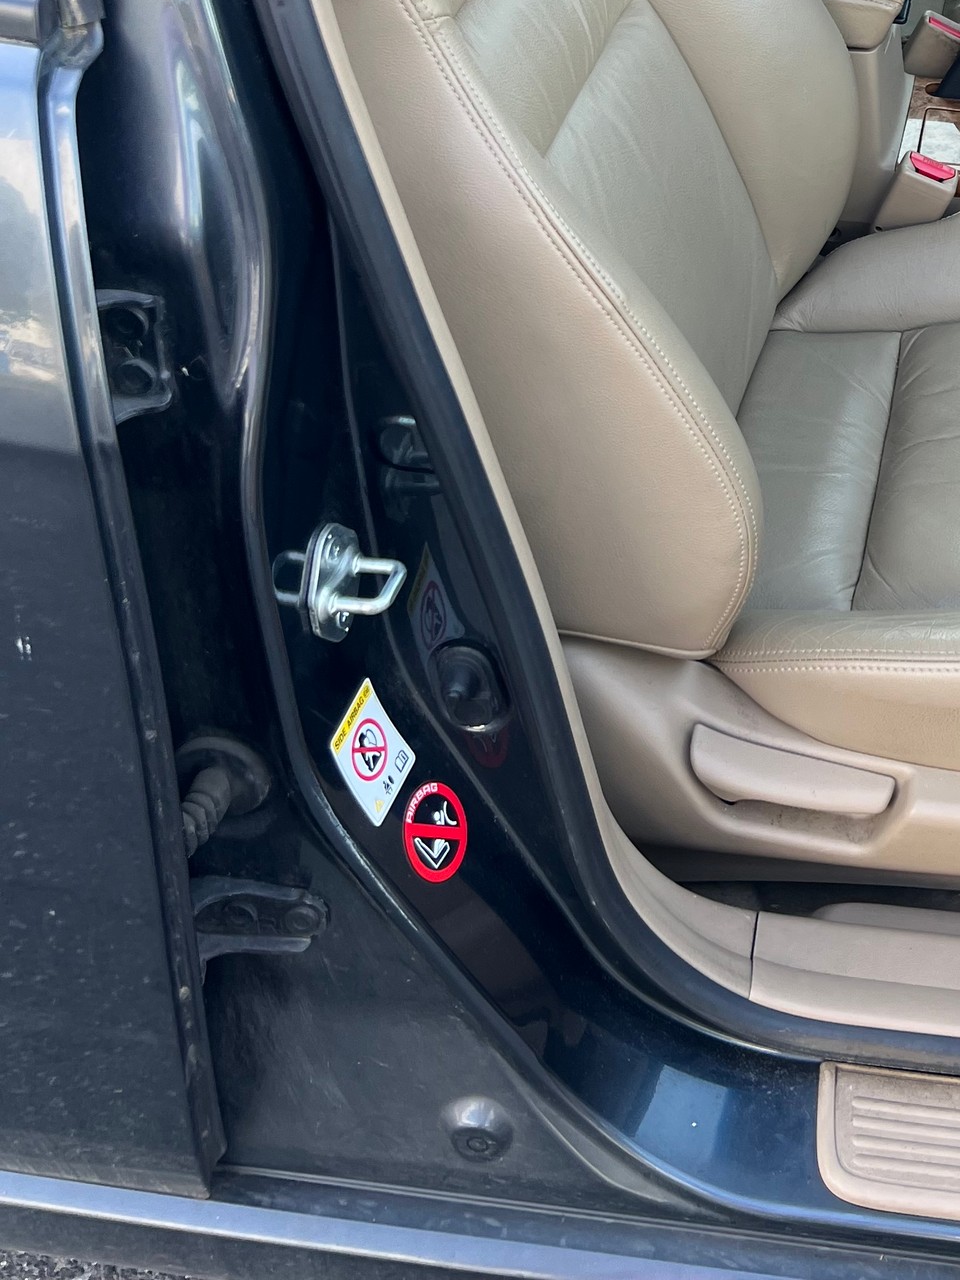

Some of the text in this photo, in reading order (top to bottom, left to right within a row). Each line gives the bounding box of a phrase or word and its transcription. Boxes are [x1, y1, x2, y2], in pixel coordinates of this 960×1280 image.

[334, 696, 365, 750] SIDE AIRBAG
[405, 782, 438, 824] AIRBAG
